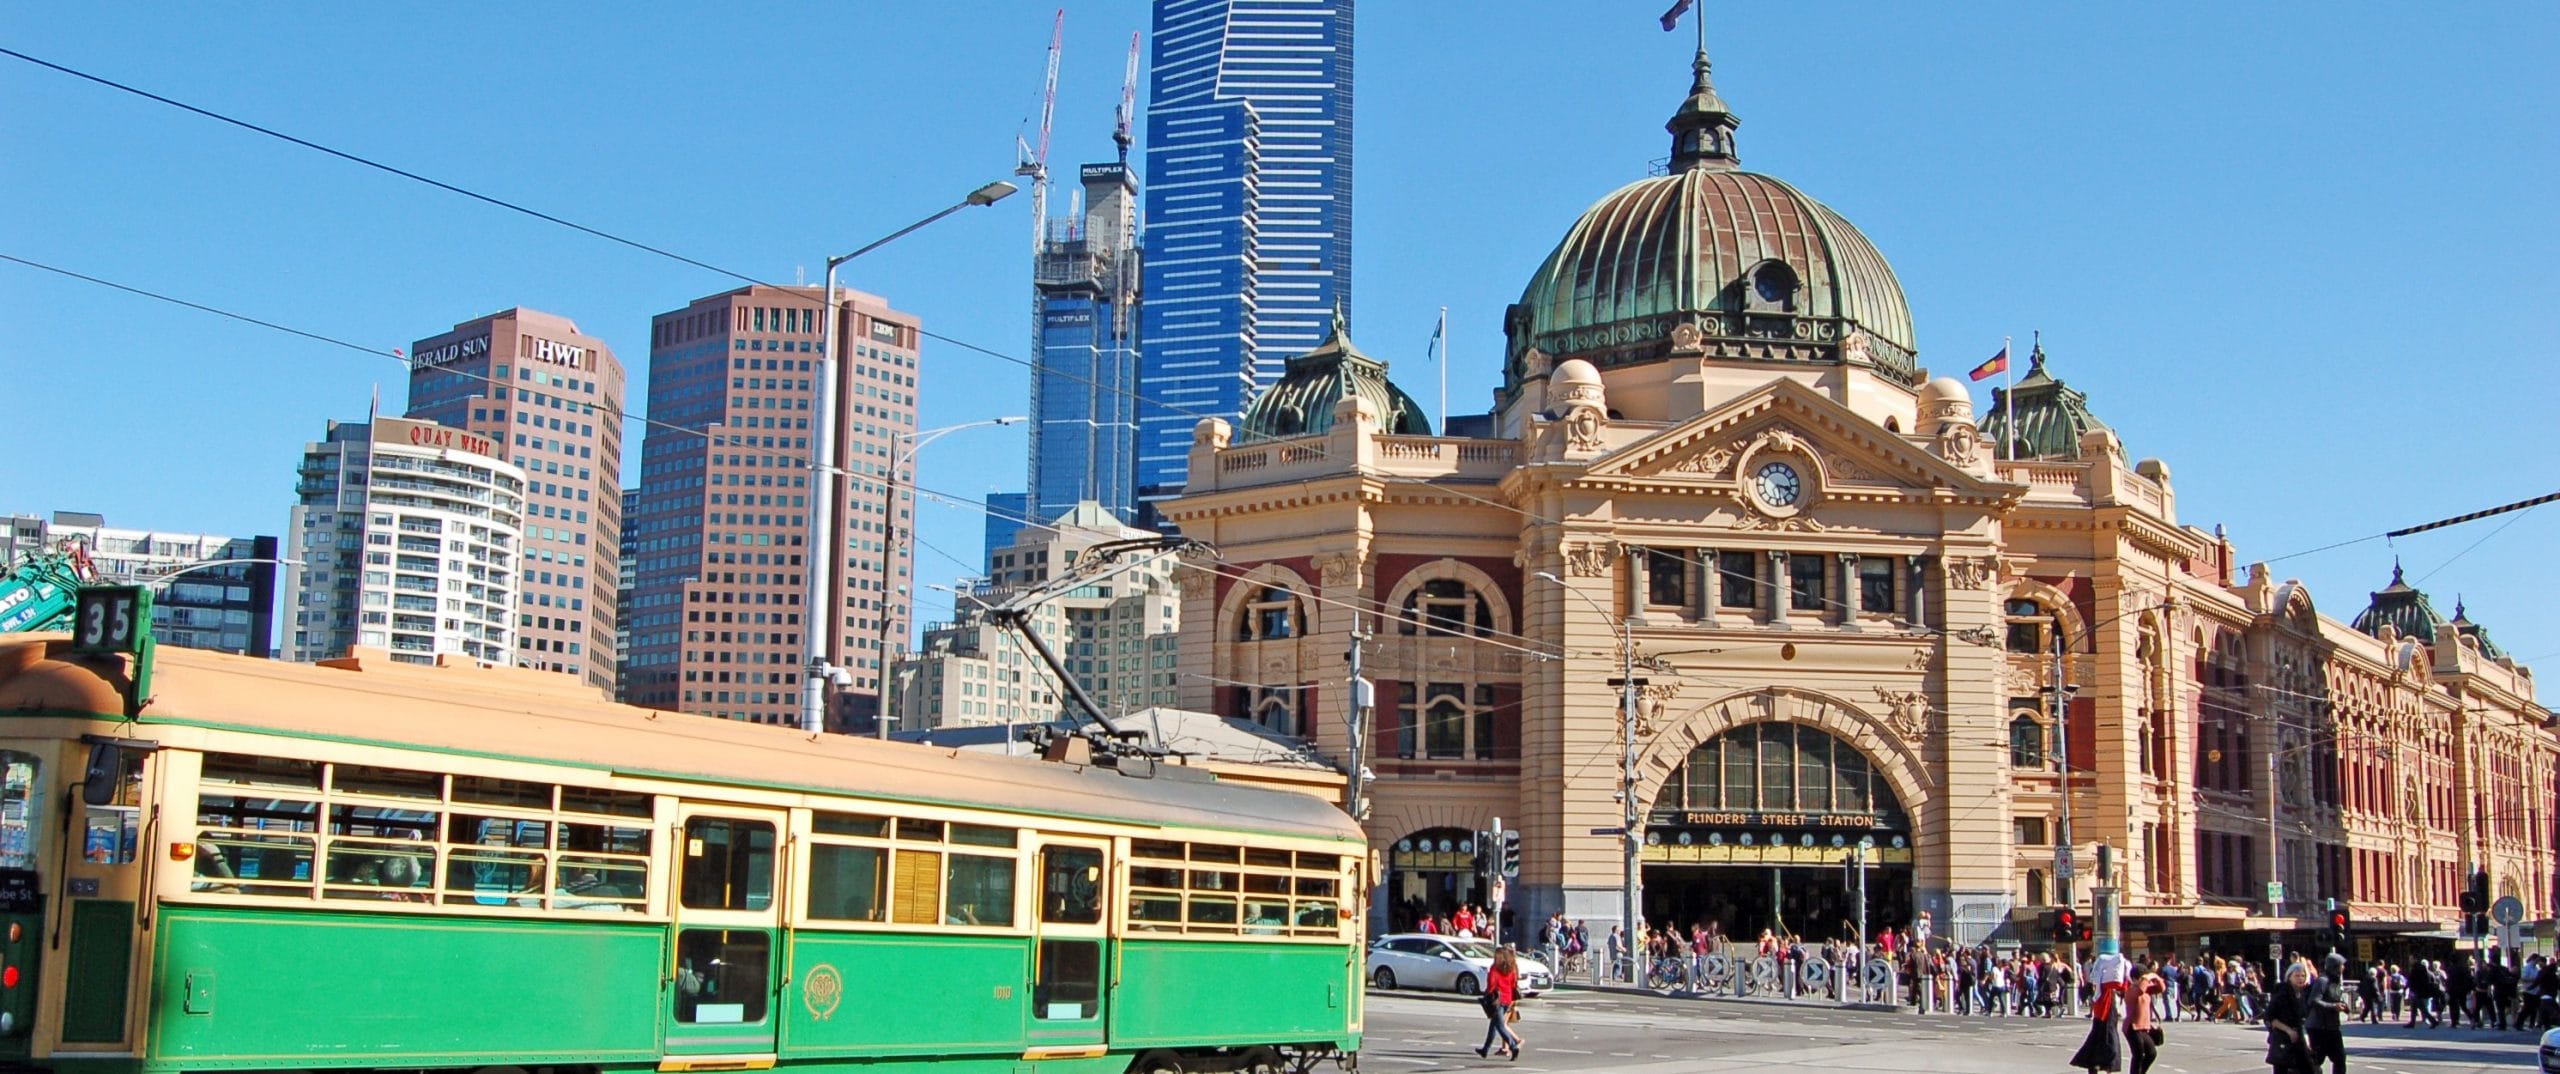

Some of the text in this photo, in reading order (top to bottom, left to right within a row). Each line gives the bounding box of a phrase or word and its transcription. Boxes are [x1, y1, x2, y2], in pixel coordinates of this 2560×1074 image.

[1083, 166, 1123, 174] MULTIPLEX
[1047, 314, 1090, 323] MULTIPLEX
[873, 321, 895, 337] IBM
[462, 336, 490, 357] SUN
[537, 338, 584, 367] HWT
[410, 425, 490, 456] QUAY WEST
[86, 599, 131, 645] 35
[1687, 813, 1874, 827] FLINDERS STREET STATION
